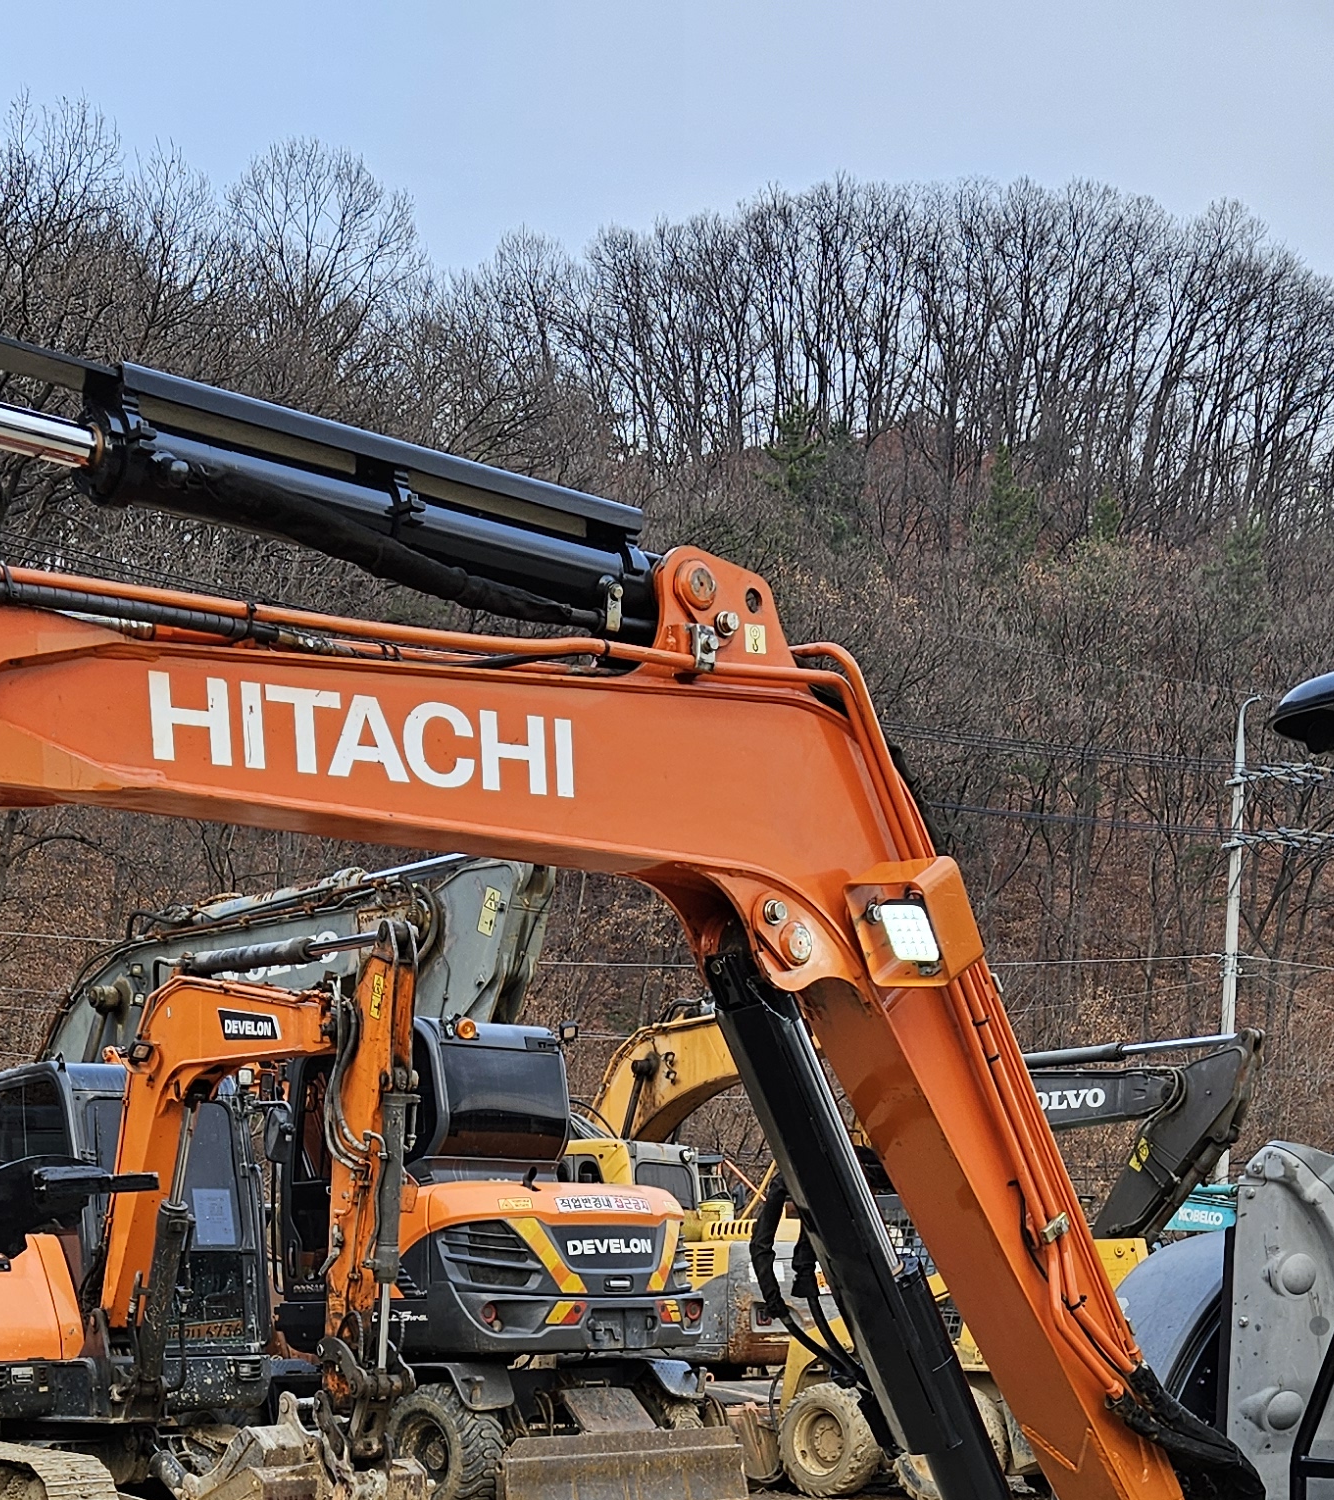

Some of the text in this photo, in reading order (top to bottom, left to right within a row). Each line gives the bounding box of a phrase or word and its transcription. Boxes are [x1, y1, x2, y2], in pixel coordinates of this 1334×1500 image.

[148, 670, 574, 798] HITACHI
[224, 1018, 272, 1037] DEVELON
[1178, 1208, 1223, 1226] KOBELCO
[567, 1238, 652, 1256] DEVELON
